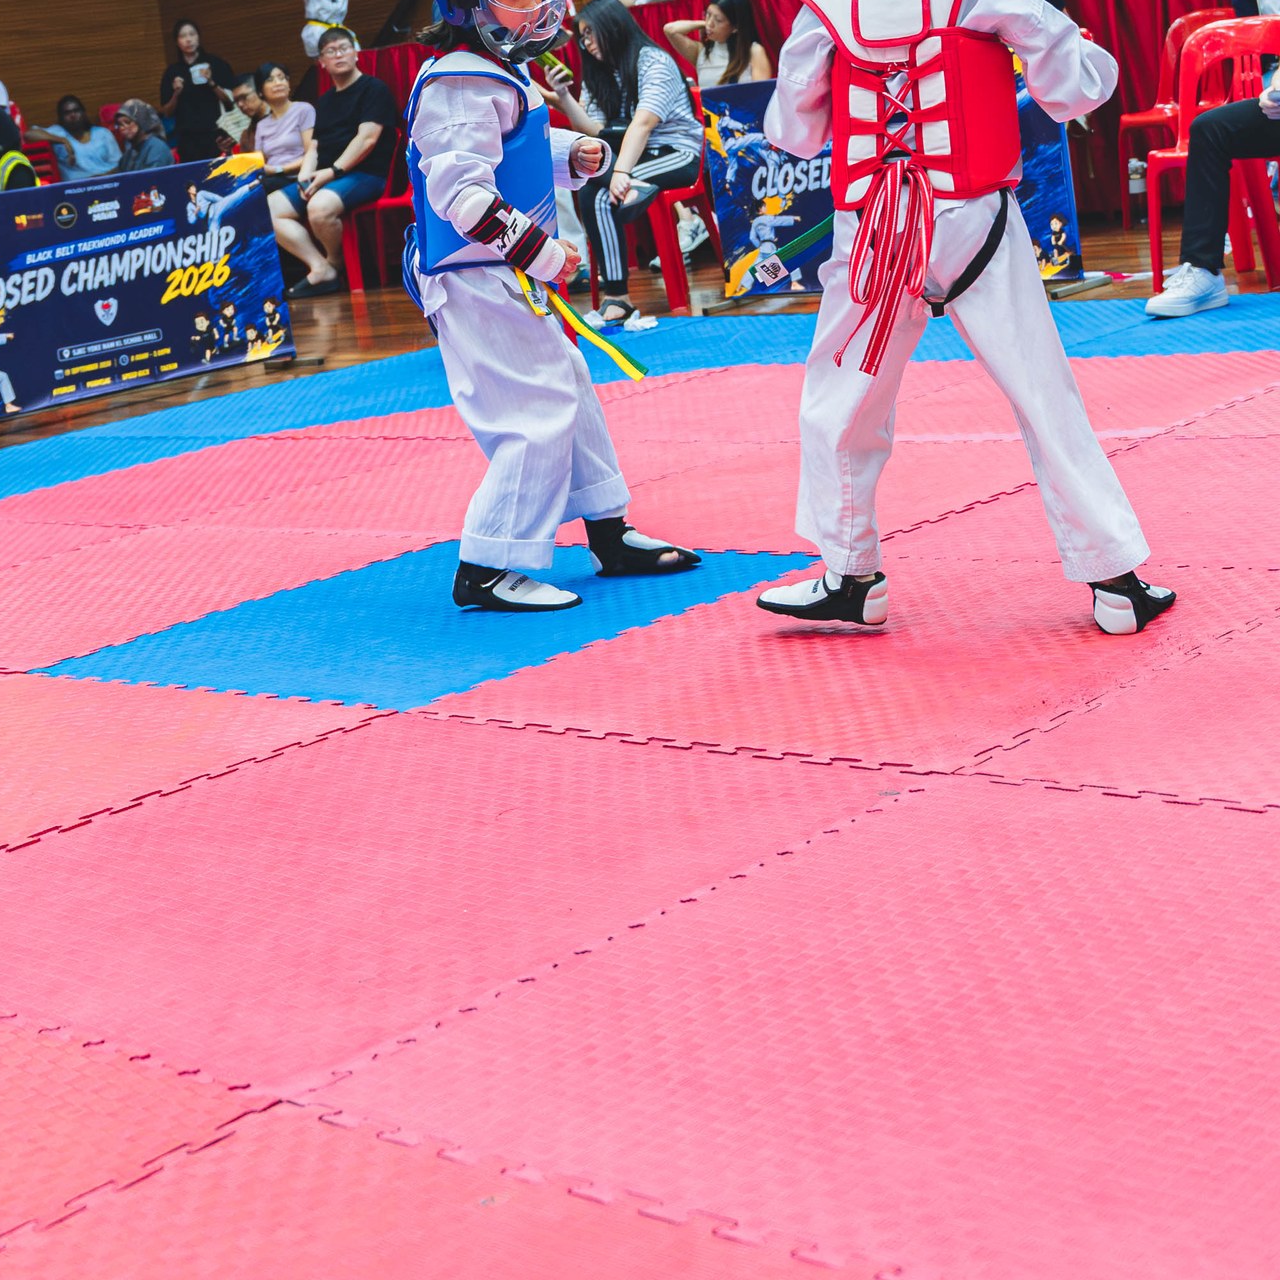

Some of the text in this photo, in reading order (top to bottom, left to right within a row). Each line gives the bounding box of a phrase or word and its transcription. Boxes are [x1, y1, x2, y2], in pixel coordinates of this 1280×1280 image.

[751, 156, 832, 201] CLOSED
[25, 225, 164, 265] BLACK BELT TAEKWONDO ACADEMY
[60, 225, 236, 297] CHAMPIONSHIP
[160, 254, 231, 305] 2026
